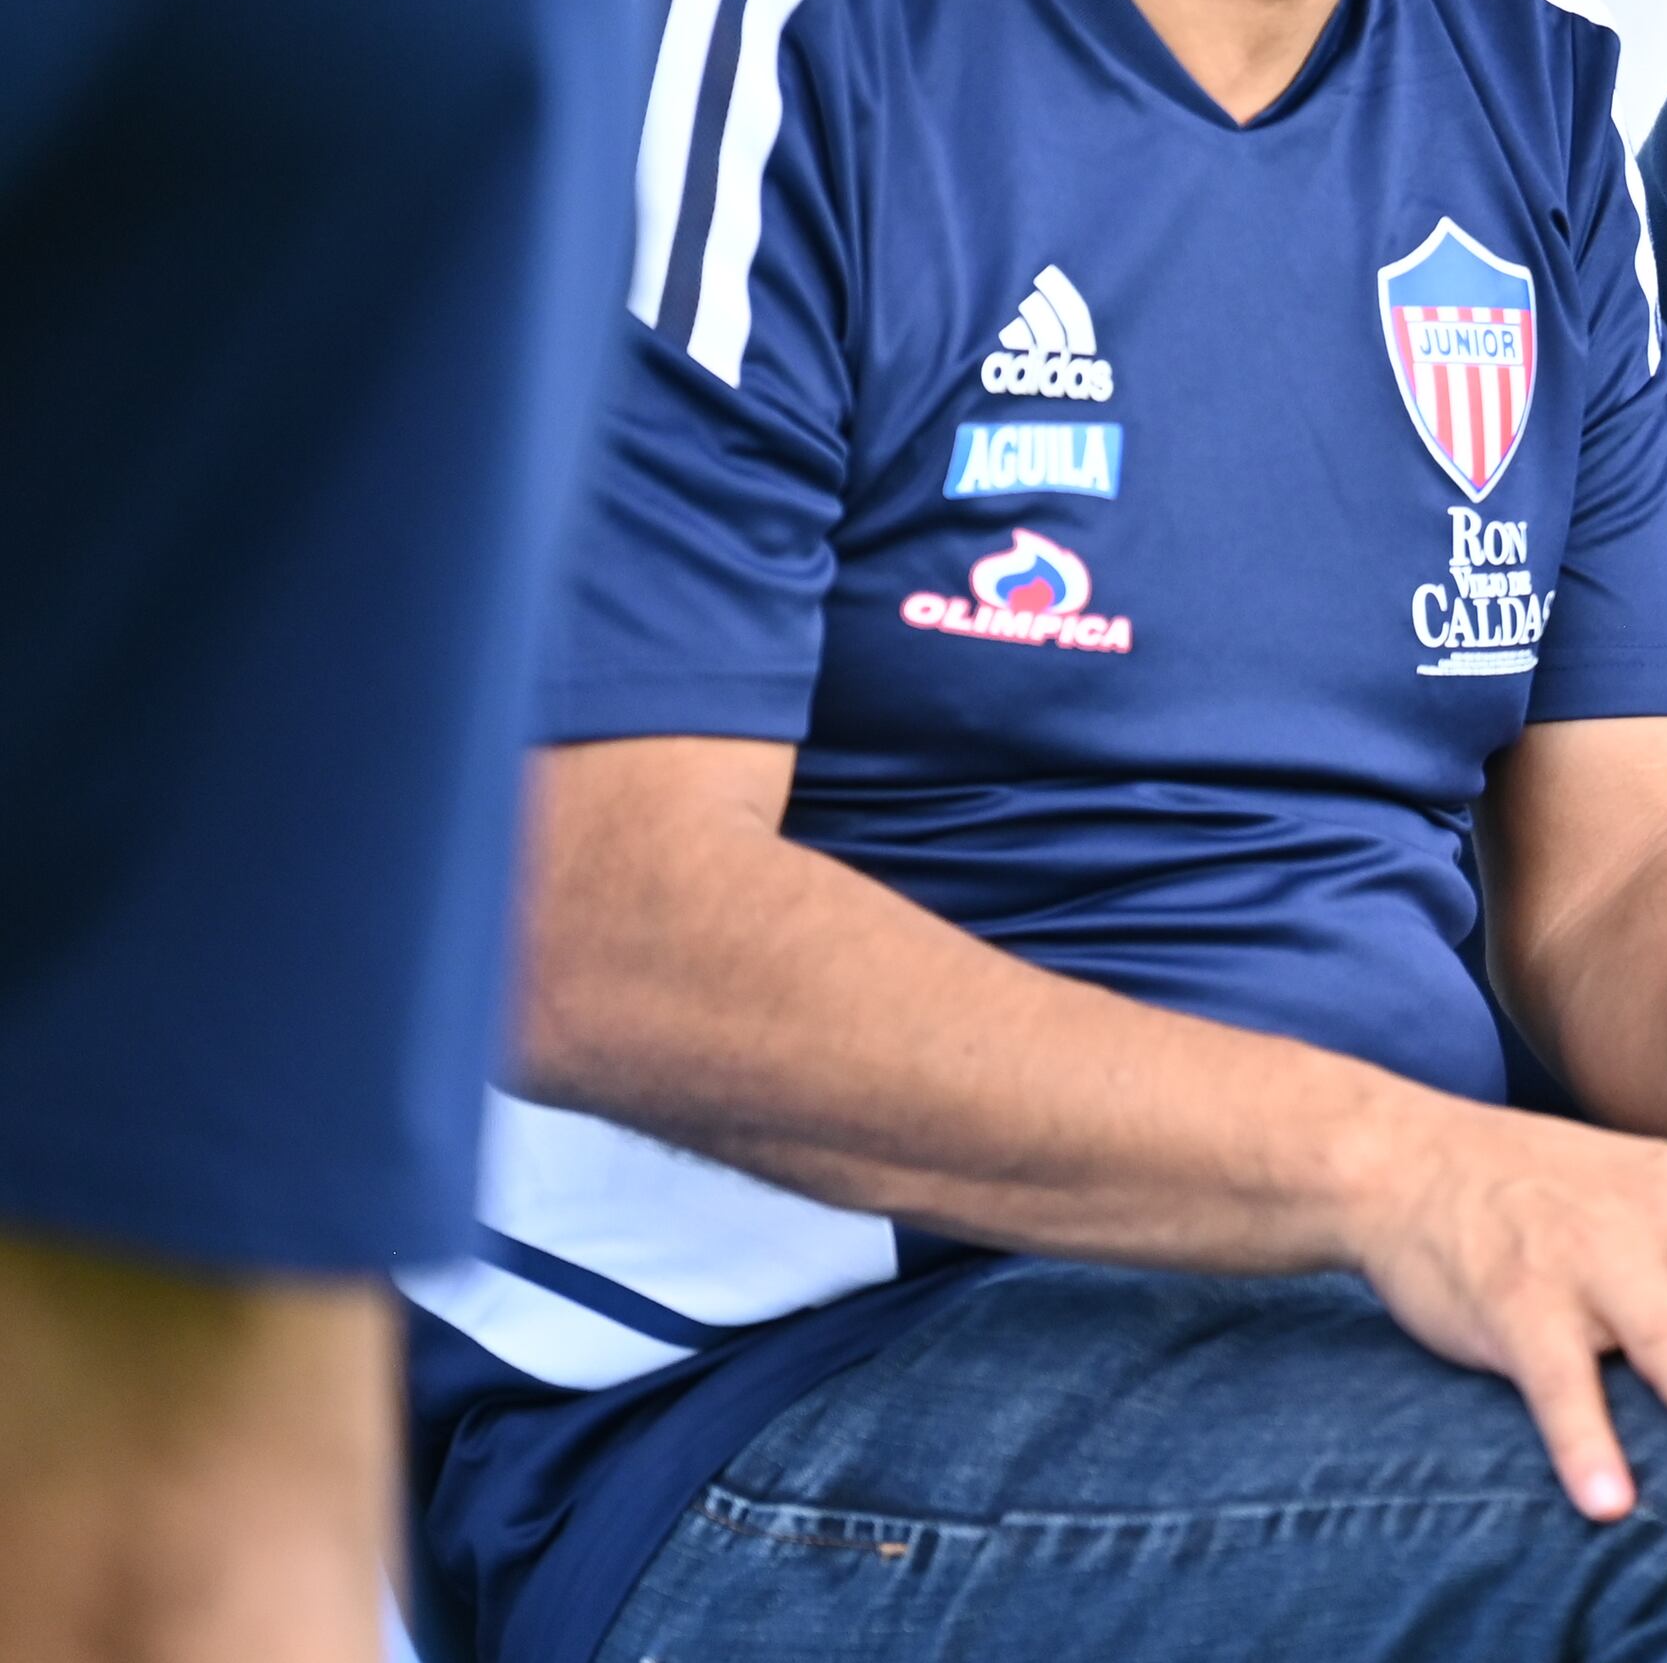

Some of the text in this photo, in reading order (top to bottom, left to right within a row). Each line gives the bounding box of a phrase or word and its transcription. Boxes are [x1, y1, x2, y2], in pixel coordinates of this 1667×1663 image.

[1419, 328, 1516, 358] JUNIOR
[980, 346, 1114, 402] adidas
[955, 425, 1111, 494] AGUILA
[1447, 506, 1528, 567] RON
[901, 592, 1132, 653] OLIMPICA
